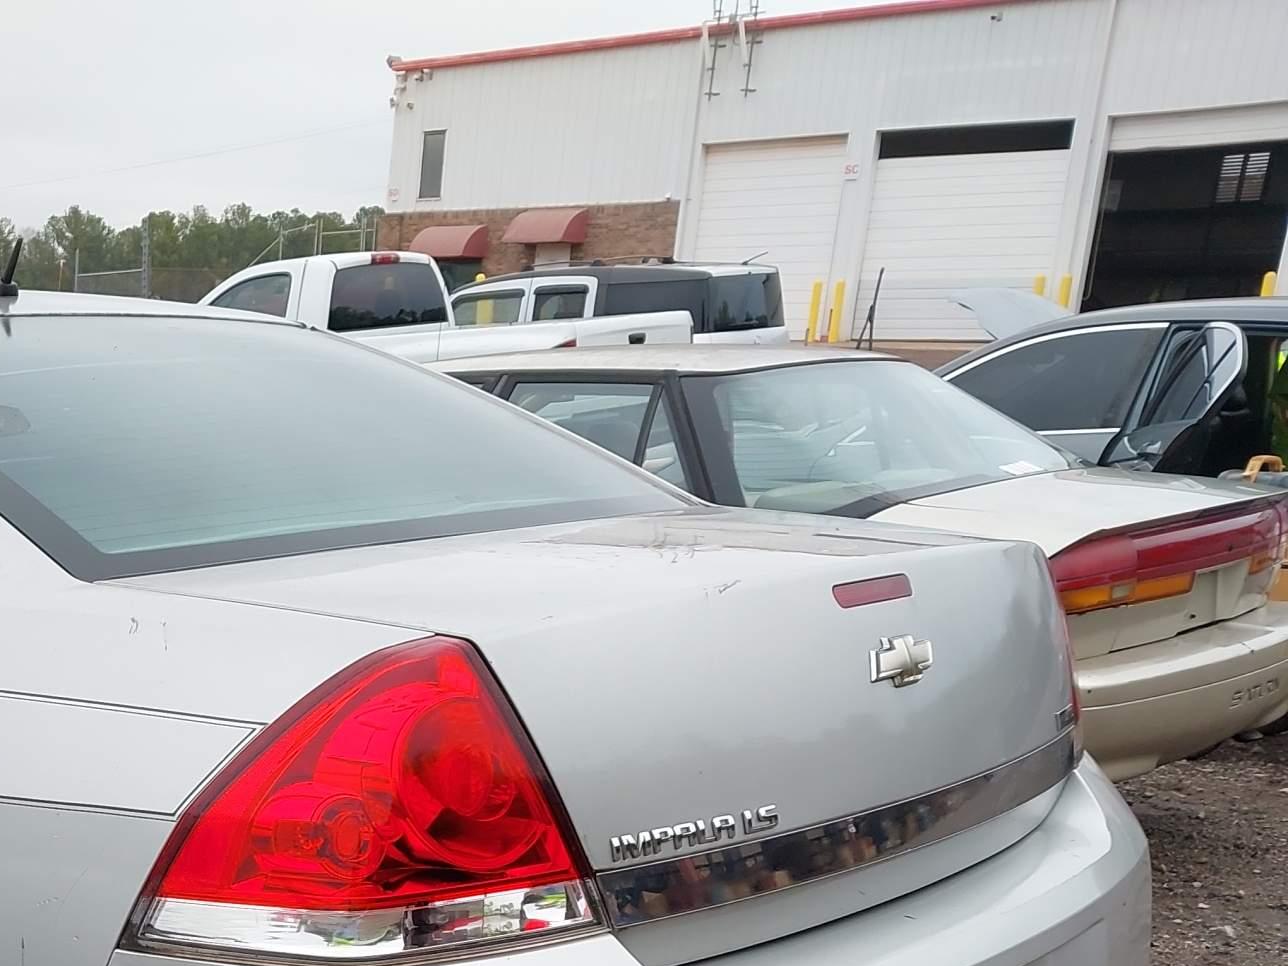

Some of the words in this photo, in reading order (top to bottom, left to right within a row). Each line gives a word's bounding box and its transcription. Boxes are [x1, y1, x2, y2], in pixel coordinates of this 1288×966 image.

[844, 164, 860, 175] SC
[609, 814, 736, 863] IMPALA
[742, 804, 779, 835] LS
